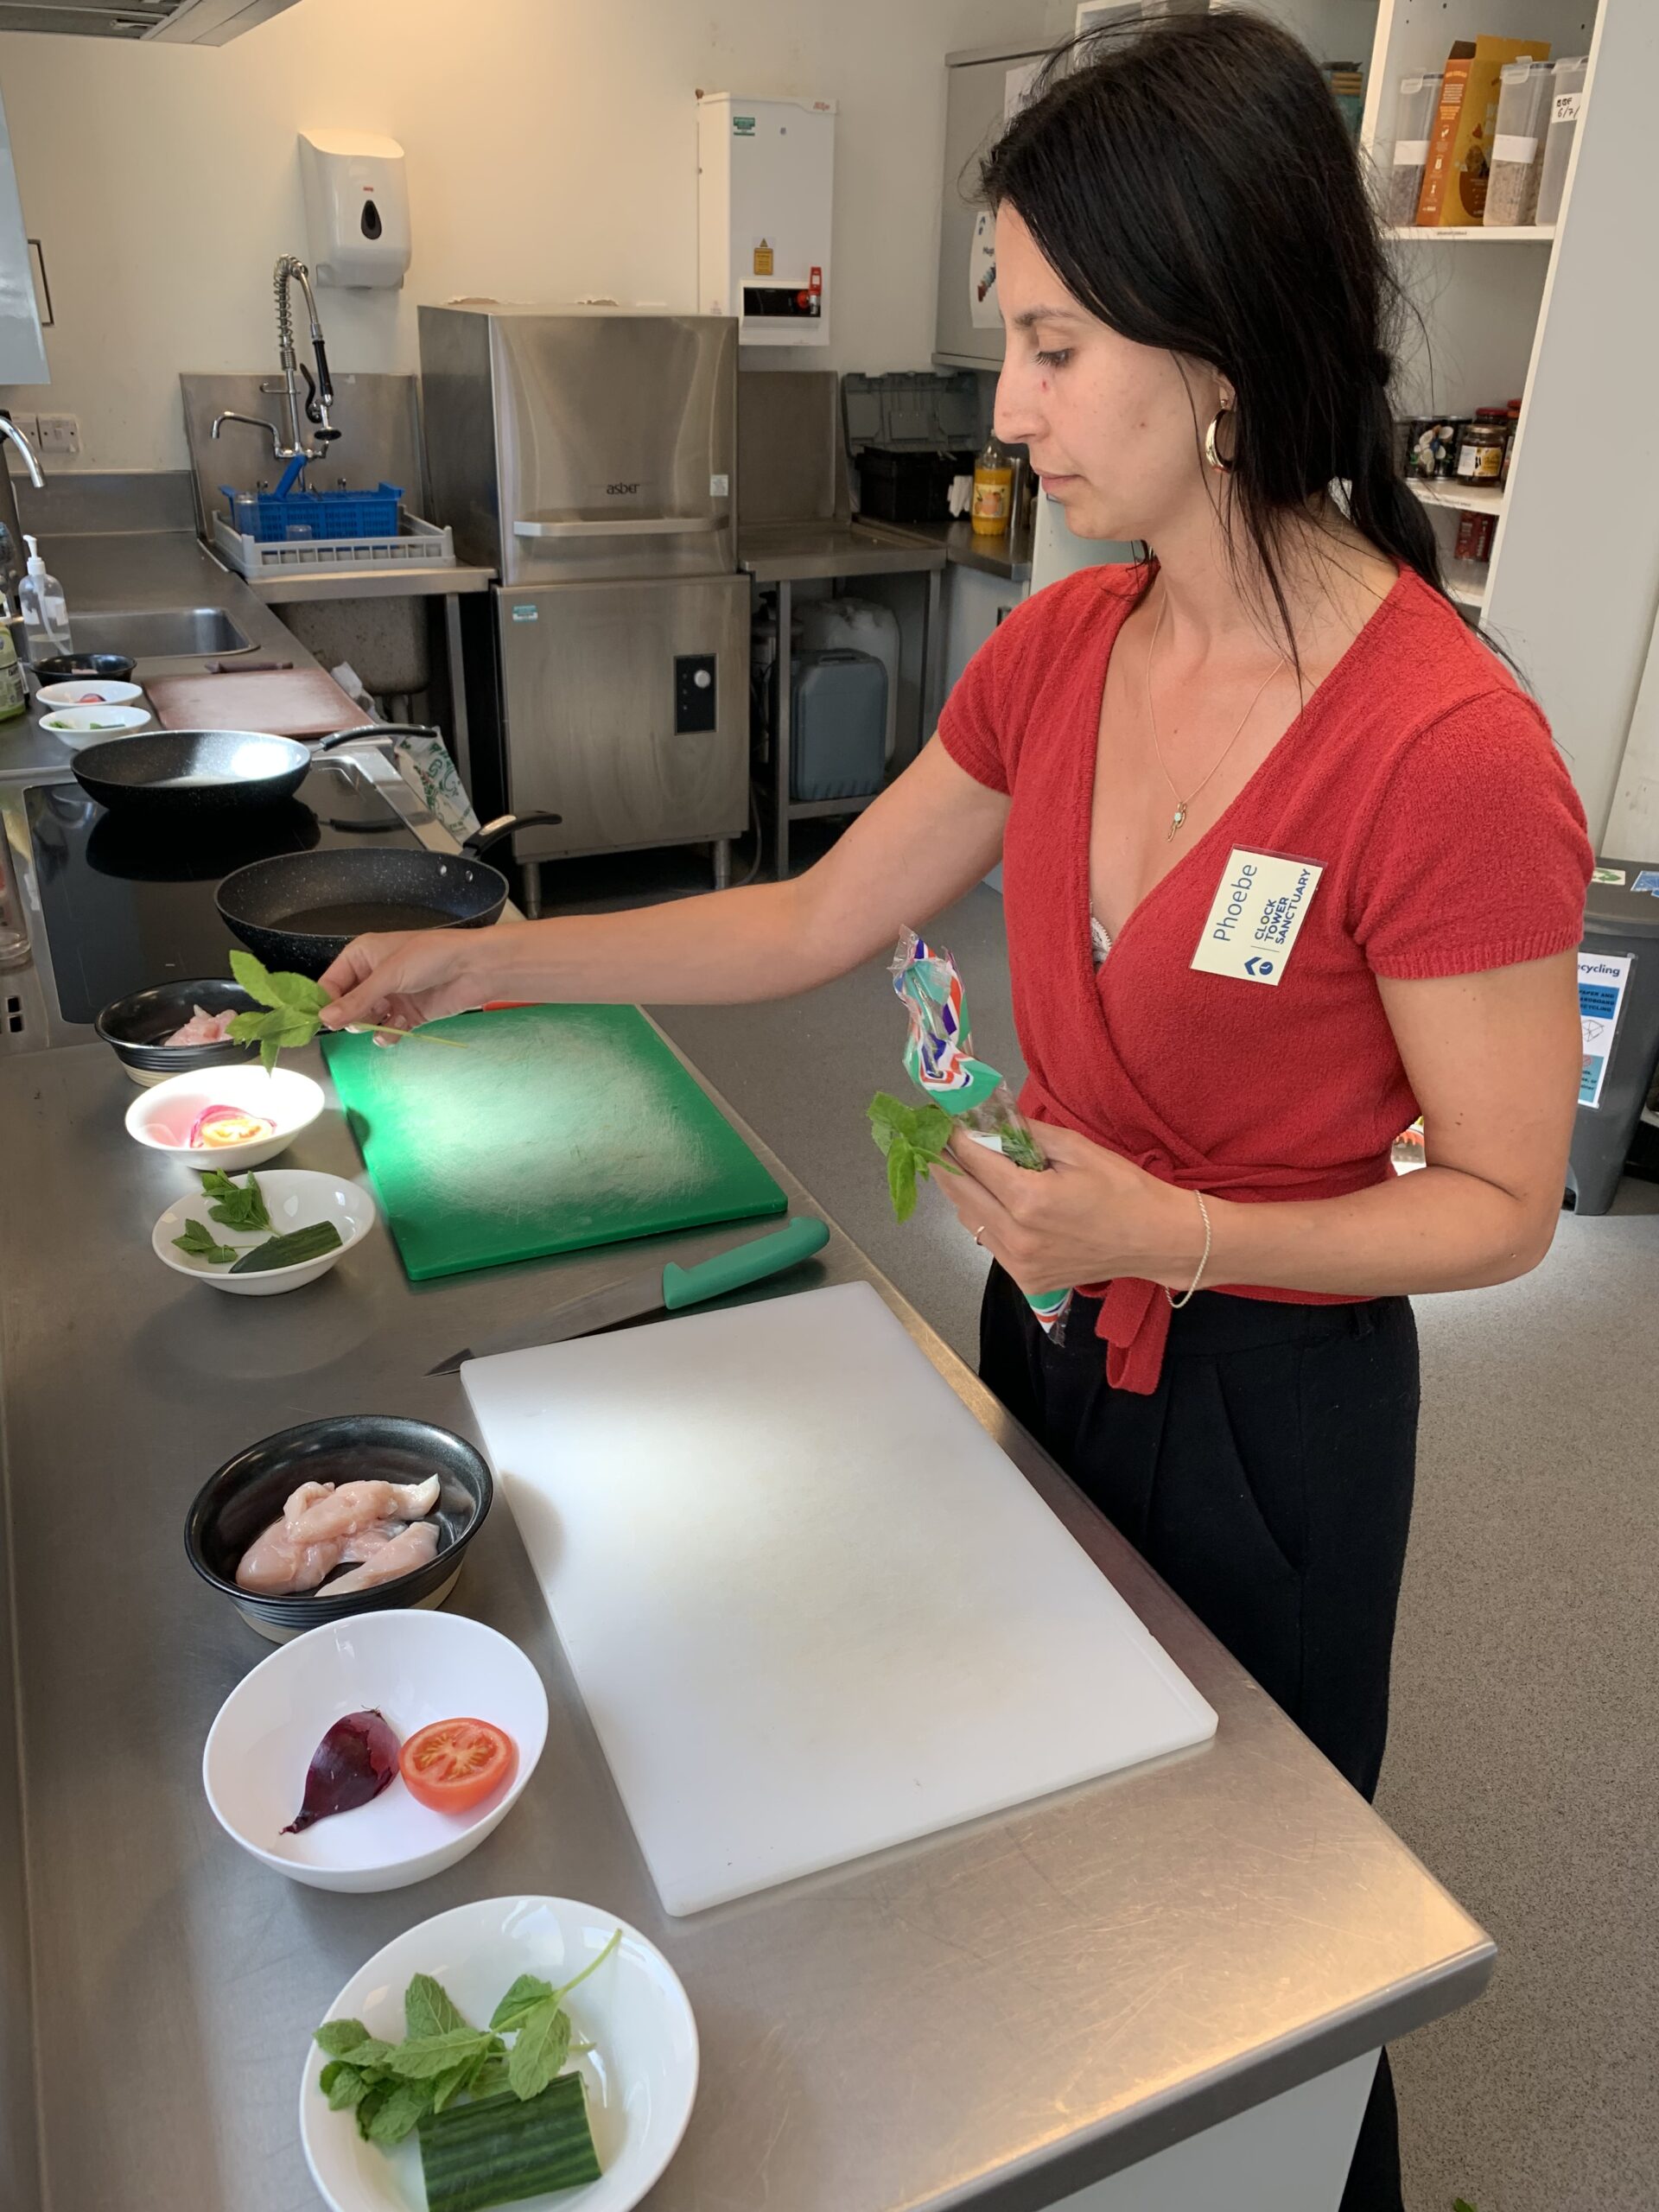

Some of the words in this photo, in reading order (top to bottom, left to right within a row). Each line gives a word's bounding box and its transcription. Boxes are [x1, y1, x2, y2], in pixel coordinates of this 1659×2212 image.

[1557, 105, 1580, 118] 6/7/
[607, 482, 639, 495] asber
[1212, 864, 1257, 942] Phoebe
[1275, 868, 1311, 945] SANCTUARY
[1255, 899, 1277, 940] CLOCK
[1264, 897, 1289, 942] TOWER
[1578, 963, 1620, 977] cycling
[1580, 996, 1615, 1006] ARDBOARD
[1580, 1003, 1612, 1013] ECYCLING
